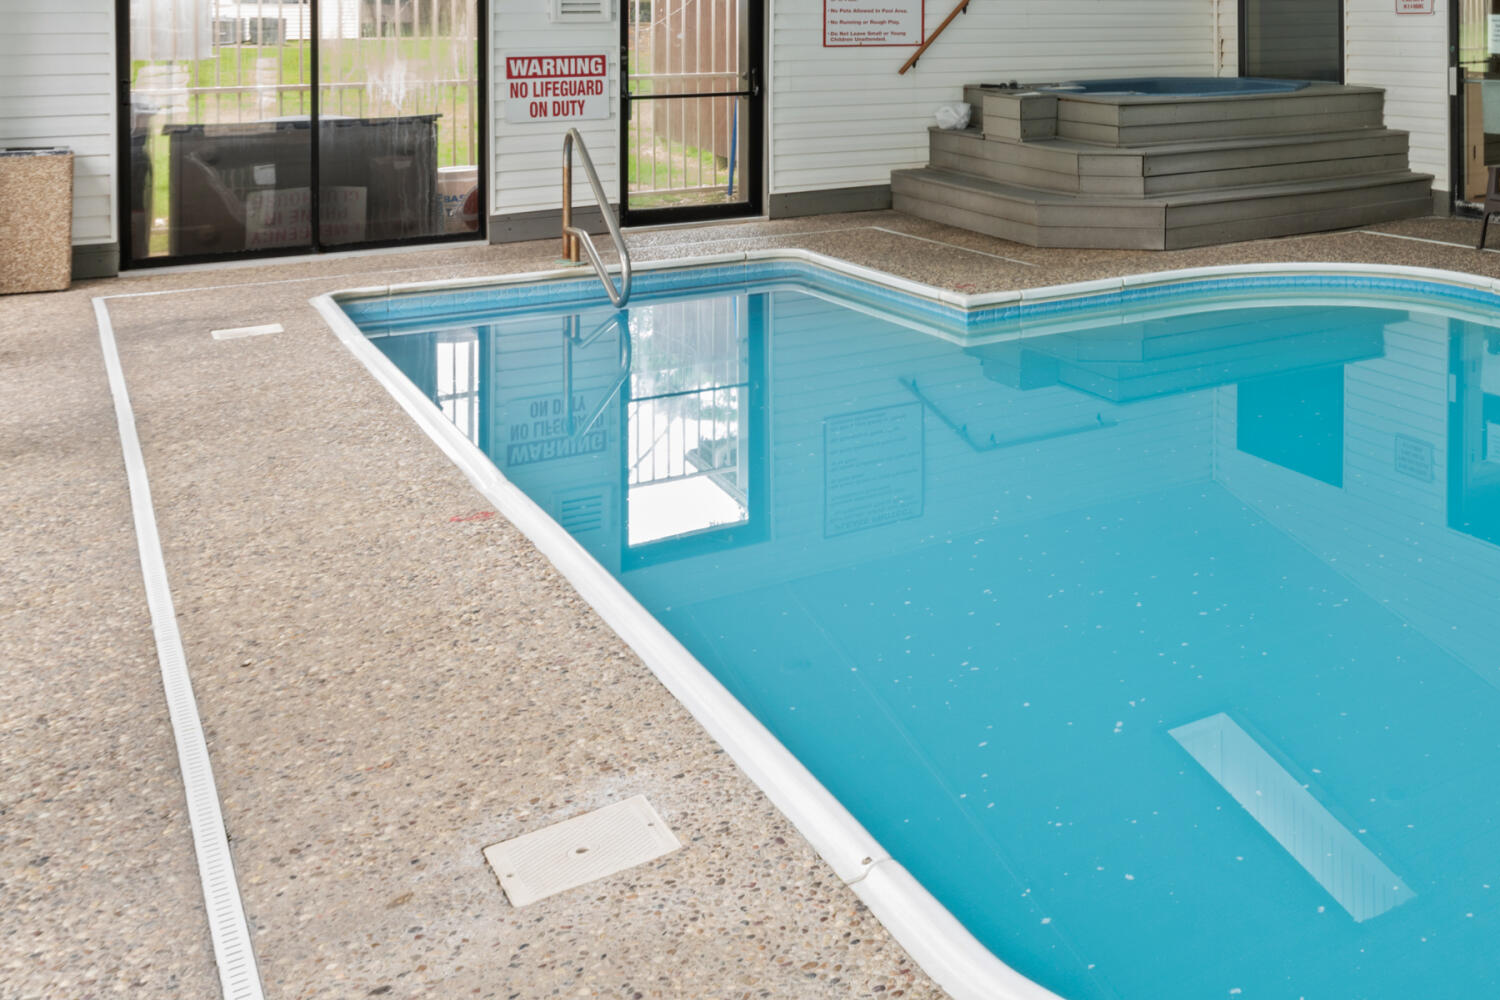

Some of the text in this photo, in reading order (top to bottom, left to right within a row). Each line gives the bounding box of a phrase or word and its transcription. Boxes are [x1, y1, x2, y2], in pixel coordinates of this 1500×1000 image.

[508, 57, 603, 77] WARNING
[510, 80, 603, 99] NO LIFEGUARD
[530, 100, 585, 118] ON DUTY
